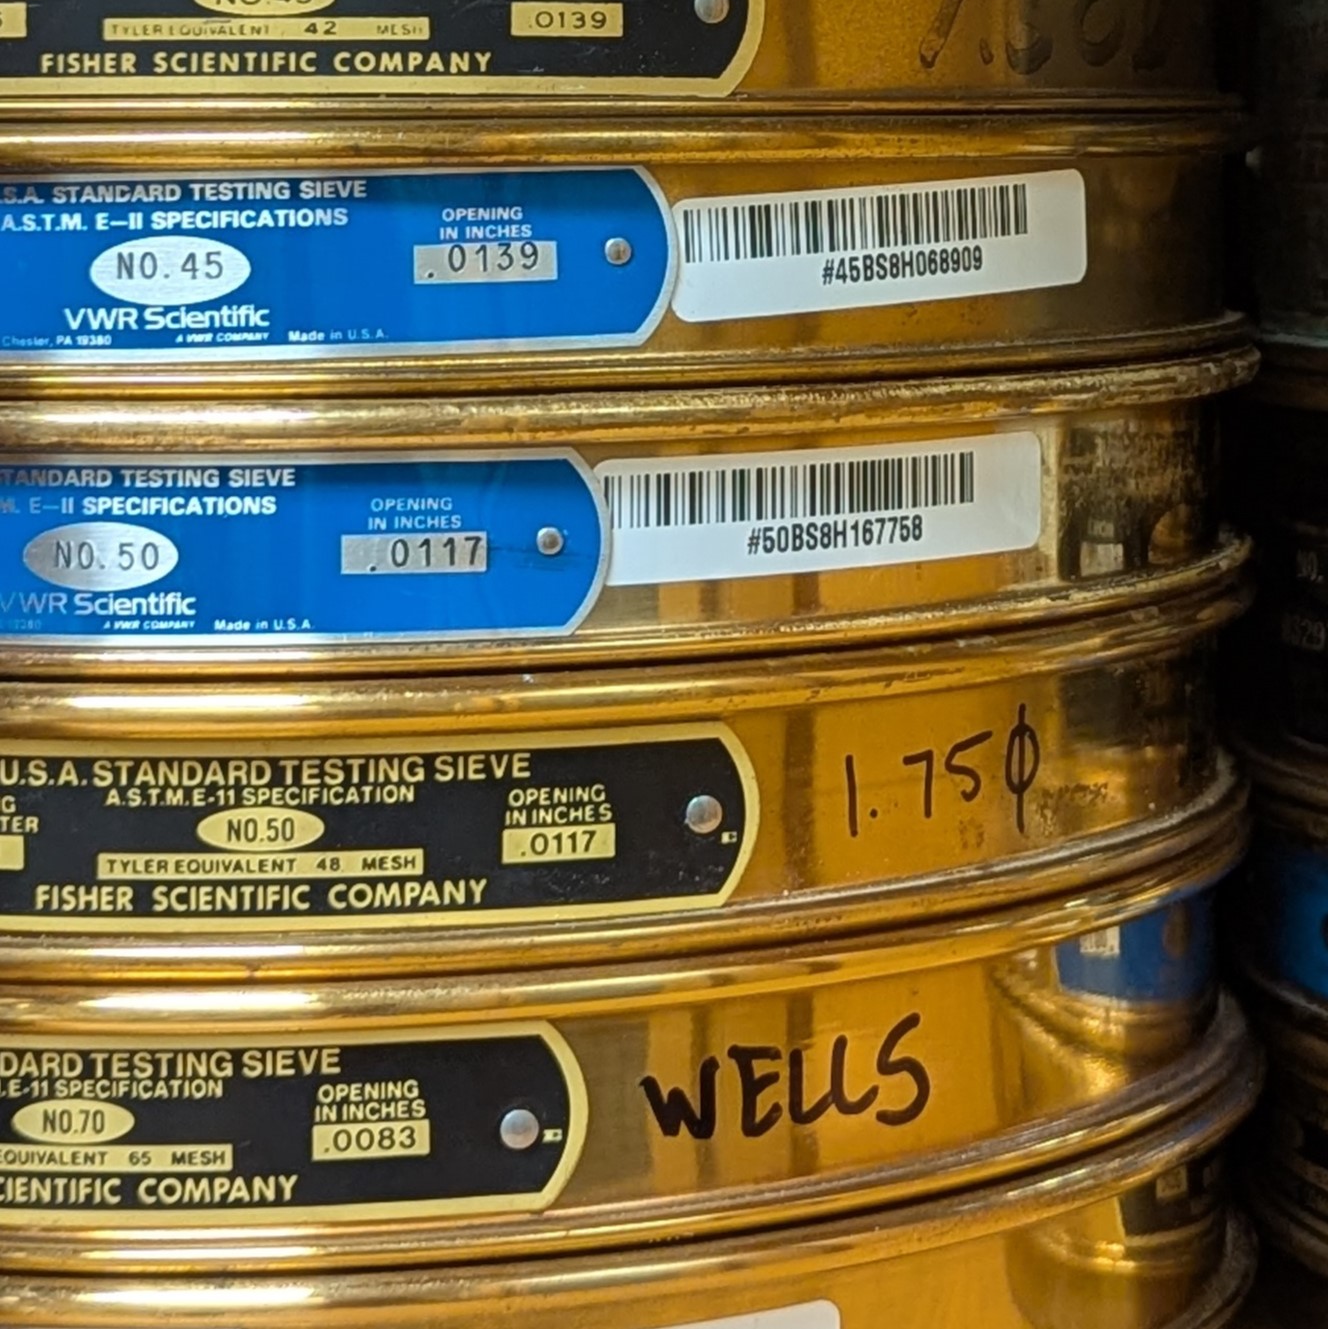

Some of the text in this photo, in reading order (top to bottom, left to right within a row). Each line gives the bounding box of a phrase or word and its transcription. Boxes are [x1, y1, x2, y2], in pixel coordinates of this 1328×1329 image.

[303, 20, 338, 37] 42
[40, 51, 493, 75] FISHER SCIENTIFIC COMPANY
[51, 180, 368, 205] STANDARD TESTING SIEVE
[1, 207, 349, 232] A.S.T.M. SPECIFICATIONS
[442, 206, 524, 223] OPENING
[439, 224, 533, 241] IN INCHES
[821, 244, 984, 286] #45BS8H068909
[64, 304, 271, 331] VWR Scientific
[55, 335, 74, 347] PA
[288, 329, 326, 343] Made
[120, 468, 297, 488] TESTING SIEVE
[82, 495, 278, 517] SPECIFICATIONS
[371, 497, 454, 513] OPENING
[367, 515, 463, 532] IN INCHES
[747, 513, 924, 556] #50BS8H167758
[0, 591, 197, 616] VWR Scientific
[214, 618, 251, 632] Made
[1, 753, 532, 788] U.S.A. STANDARD TESTING SIEVE
[243, 784, 415, 808] SPECIFICATION
[508, 784, 606, 808] OPENING
[505, 803, 613, 827] IN INCHES
[107, 855, 417, 875] TYLER EQUIVALENT 48 MESH
[35, 878, 488, 912] FISHER SCIENTIFIC COMPANY
[89, 1051, 234, 1079] TESTING
[242, 1048, 341, 1079] SIEVE
[638, 1012, 931, 1141] WELLS
[55, 1079, 224, 1100] SPECIFICATION
[317, 1079, 420, 1105] OPENING
[314, 1098, 427, 1123] IN INCHES
[128, 1150, 226, 1167] 65 MESH
[137, 1174, 299, 1205] COMPANY
